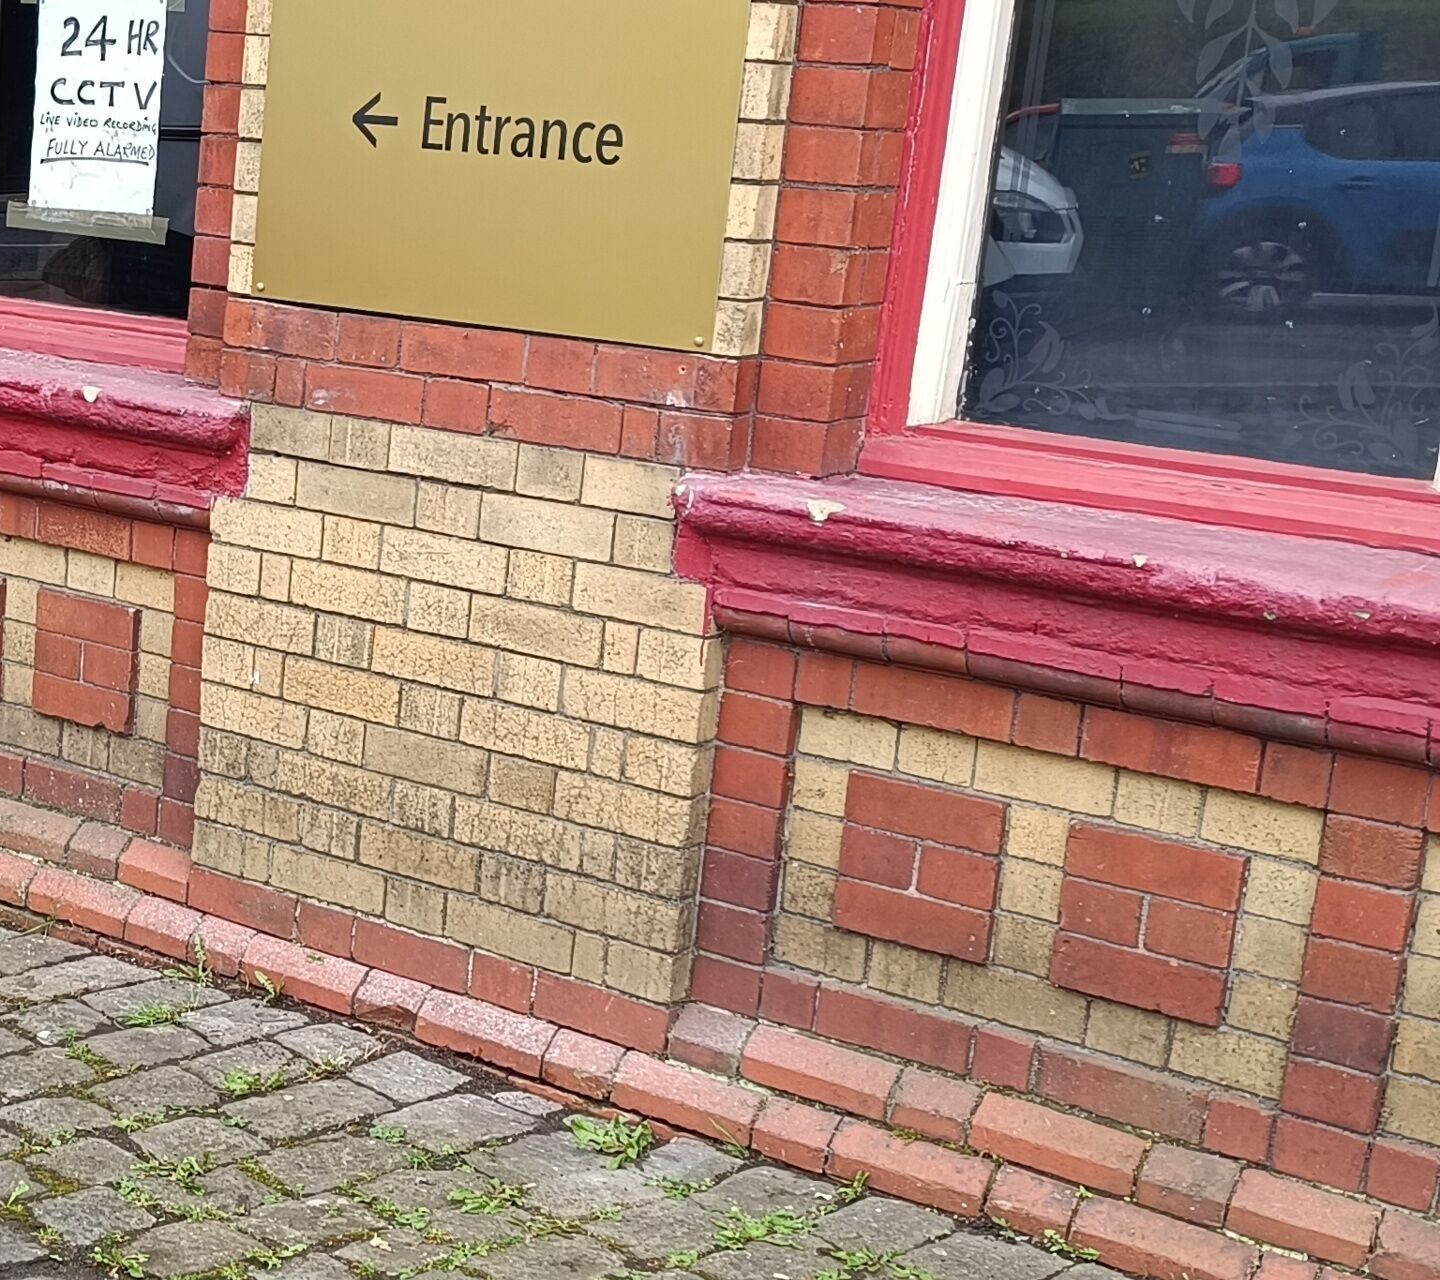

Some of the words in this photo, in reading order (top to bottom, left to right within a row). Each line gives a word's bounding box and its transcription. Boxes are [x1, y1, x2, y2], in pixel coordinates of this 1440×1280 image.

[61, 15, 116, 61] 24
[127, 19, 160, 56] HR
[50, 78, 157, 110] CCTV
[46, 138, 88, 158] FULLY
[93, 140, 156, 161] ALARMED
[420, 95, 625, 166] Entrance
